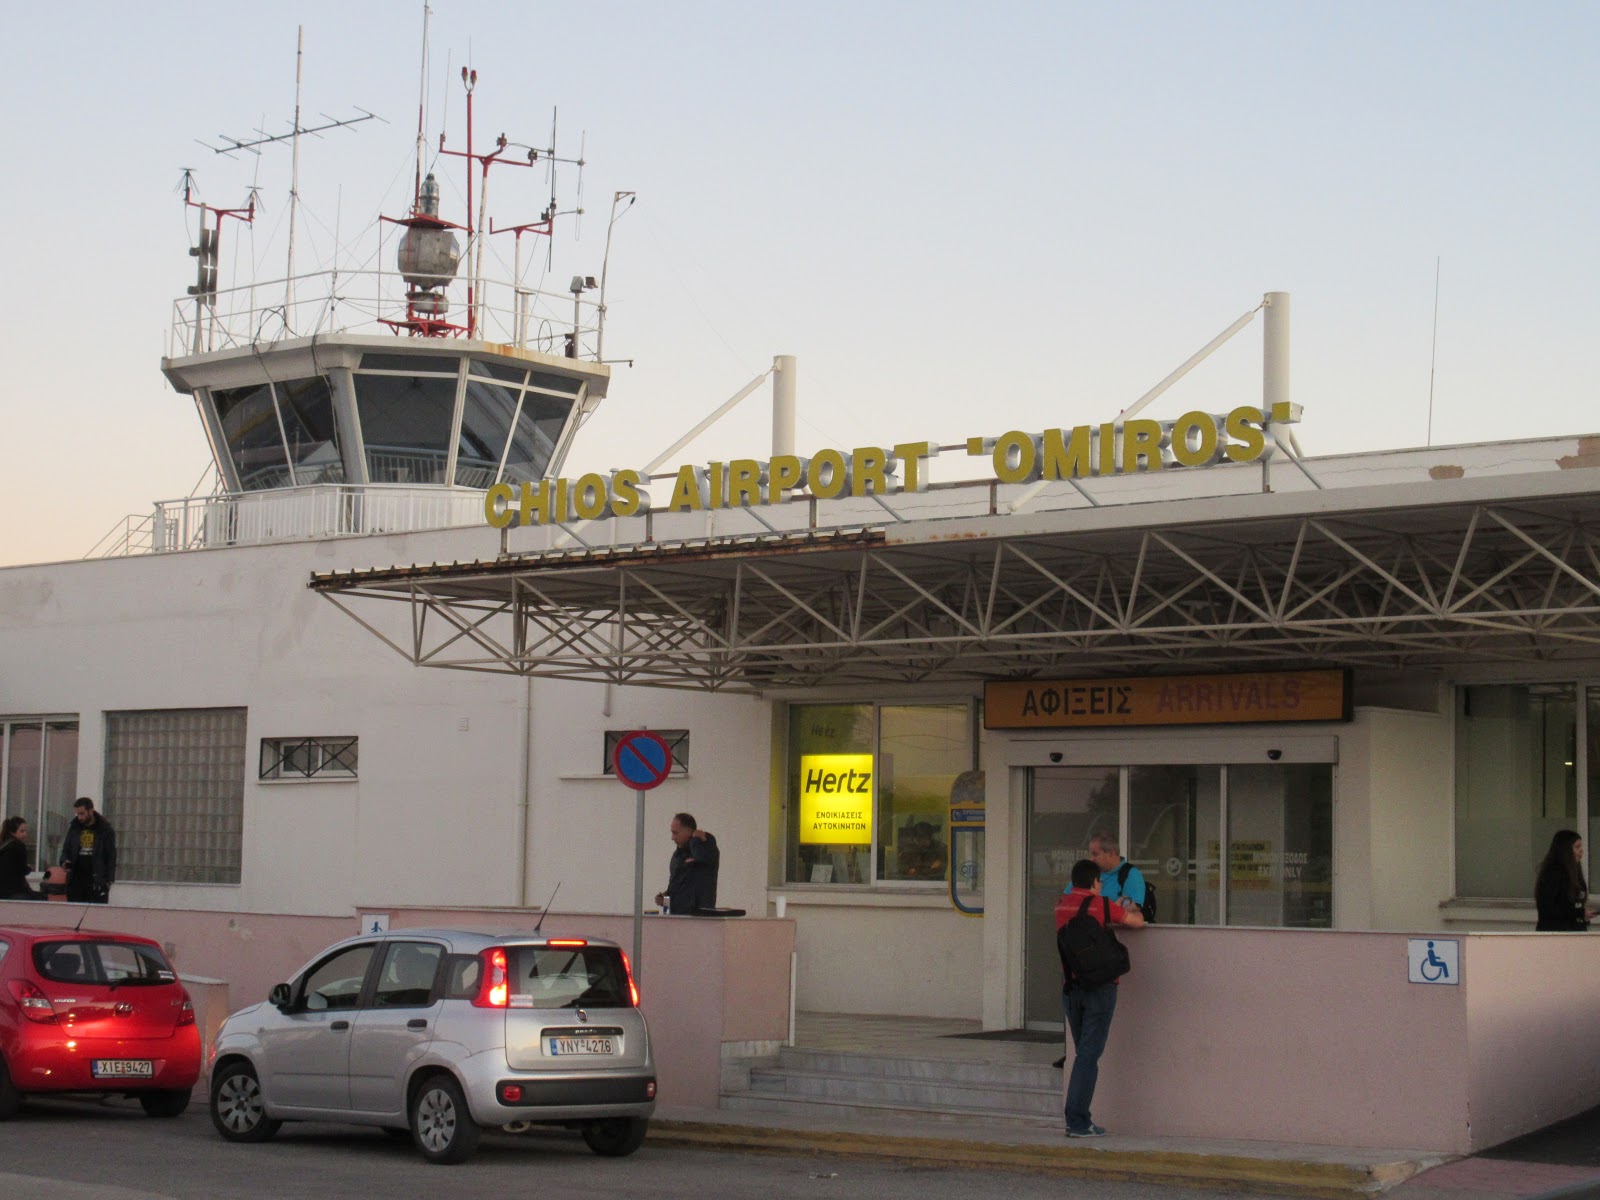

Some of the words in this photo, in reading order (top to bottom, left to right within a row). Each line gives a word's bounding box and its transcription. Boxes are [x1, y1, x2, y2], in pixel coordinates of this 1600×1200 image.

[485, 469, 645, 528] CHIOS
[668, 441, 934, 512] AIRPORT
[1021, 686, 1133, 717] ΑΦΙΞΕΙΣ
[1156, 679, 1301, 713] ARRIVALS
[805, 768, 871, 794] Hertz
[813, 822, 866, 830] ΑΥΤΟΚΙΝΗΤΩΝ
[816, 811, 863, 819] ΕΝΟΙΚΙΑΣΕΙΣ
